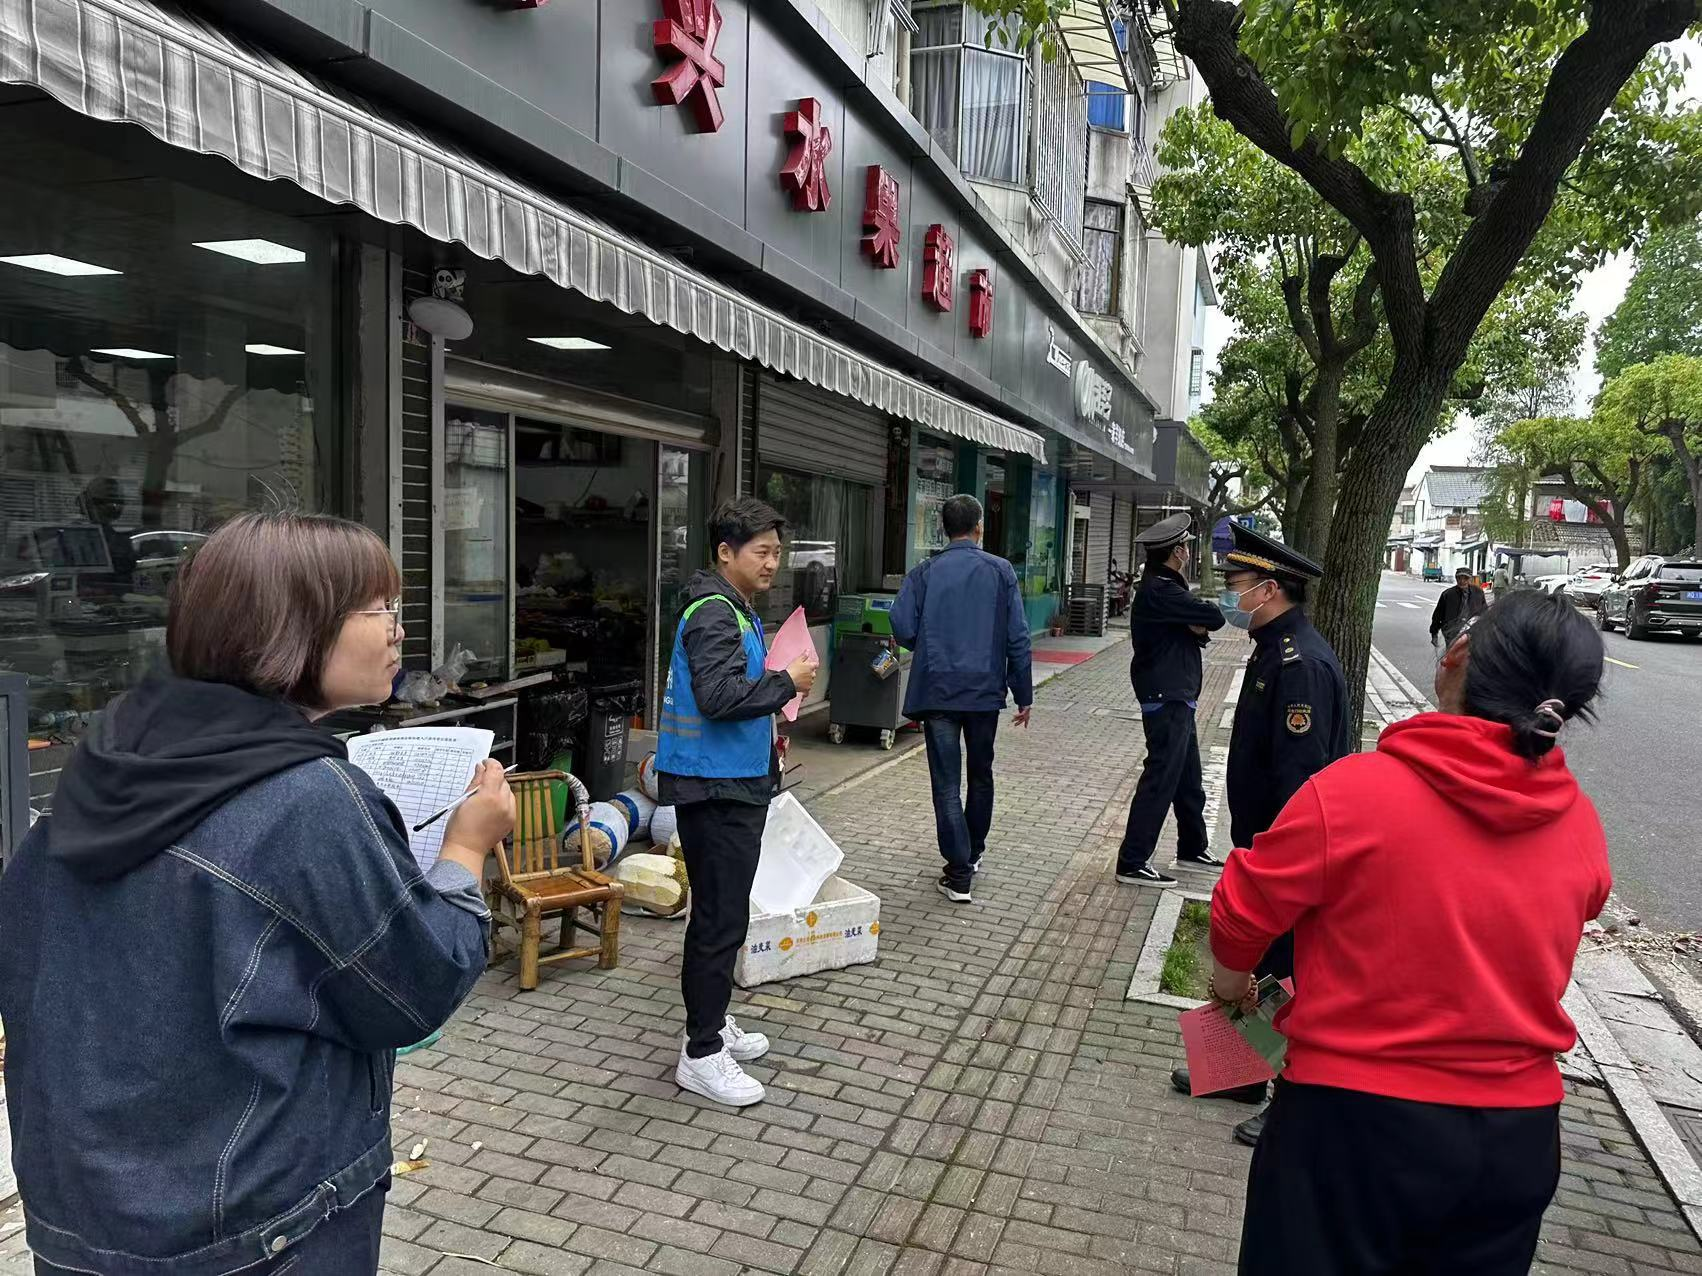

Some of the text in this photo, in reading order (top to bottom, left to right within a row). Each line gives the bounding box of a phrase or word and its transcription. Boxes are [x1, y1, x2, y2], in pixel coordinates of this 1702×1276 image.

[513, 0, 993, 338] 兴水果超市
